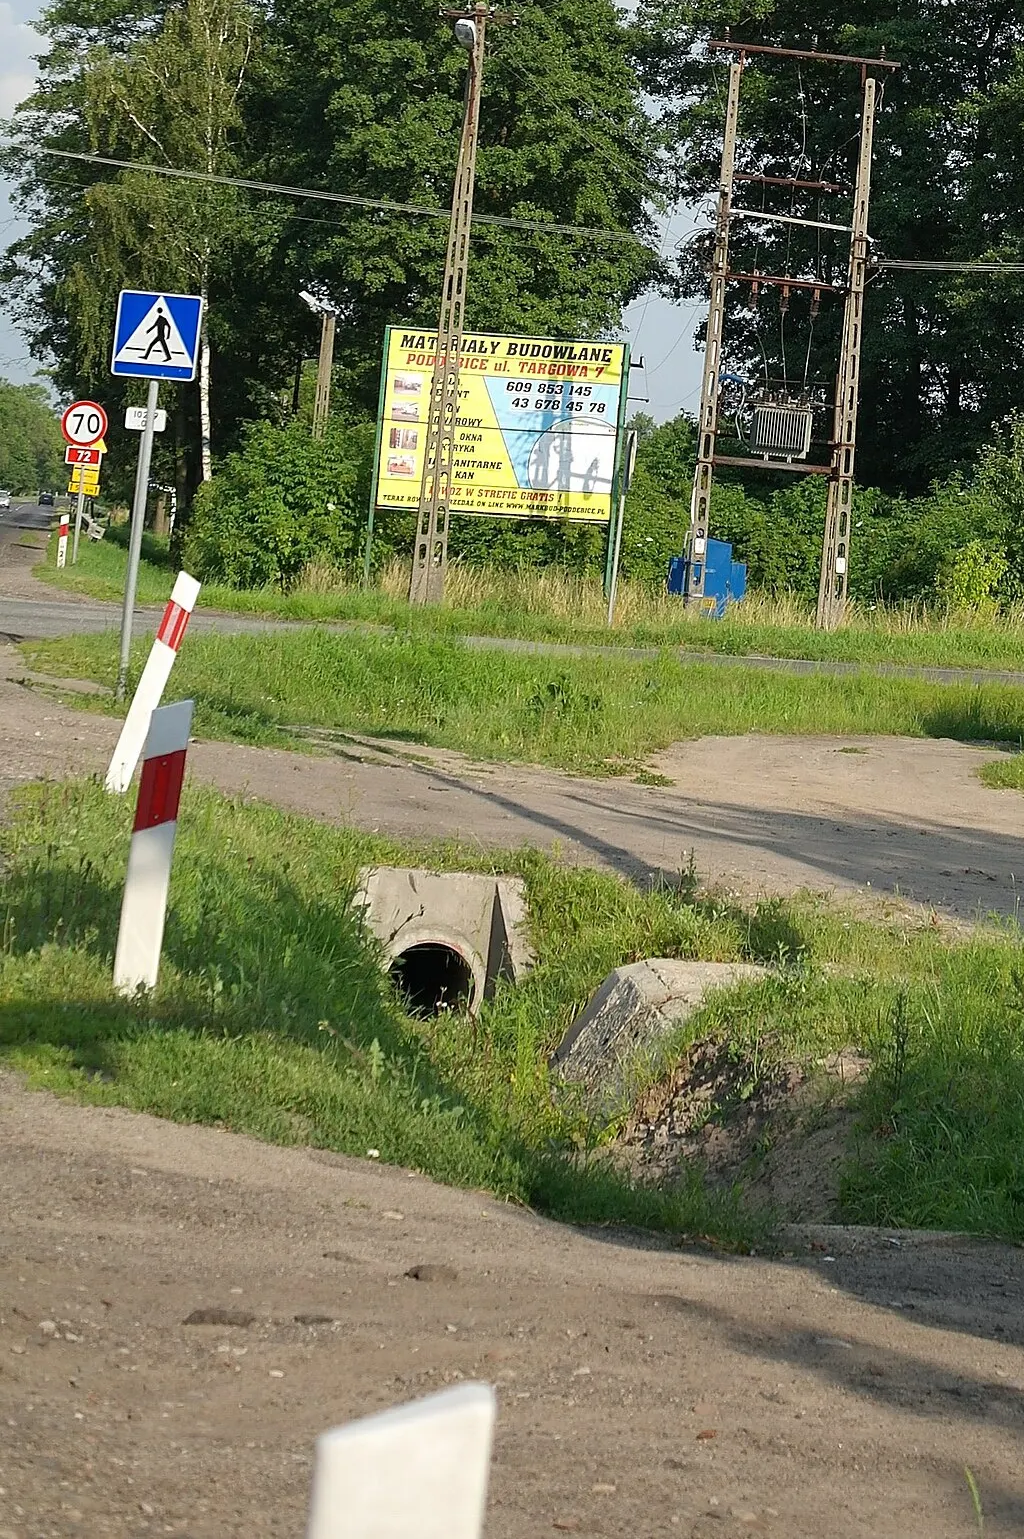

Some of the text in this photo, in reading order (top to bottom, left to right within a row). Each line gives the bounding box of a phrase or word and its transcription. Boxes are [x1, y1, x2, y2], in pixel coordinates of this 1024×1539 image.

[506, 343, 612, 362] BUDOWLANE
[494, 360, 509, 372] ul.
[518, 362, 588, 377] TARGOWA
[595, 367, 605, 378] 7
[506, 382, 592, 397] 609 853 145
[512, 398, 606, 413] 43 678 45 78
[73, 413, 100, 435] 70
[460, 433, 482, 442] OKNA
[77, 450, 91, 462] 72
[452, 459, 502, 470] ANITARNE
[455, 471, 474, 480] KAN
[466, 488, 474, 496] W
[477, 488, 517, 500] STREFIE
[520, 491, 555, 502] GRATIS
